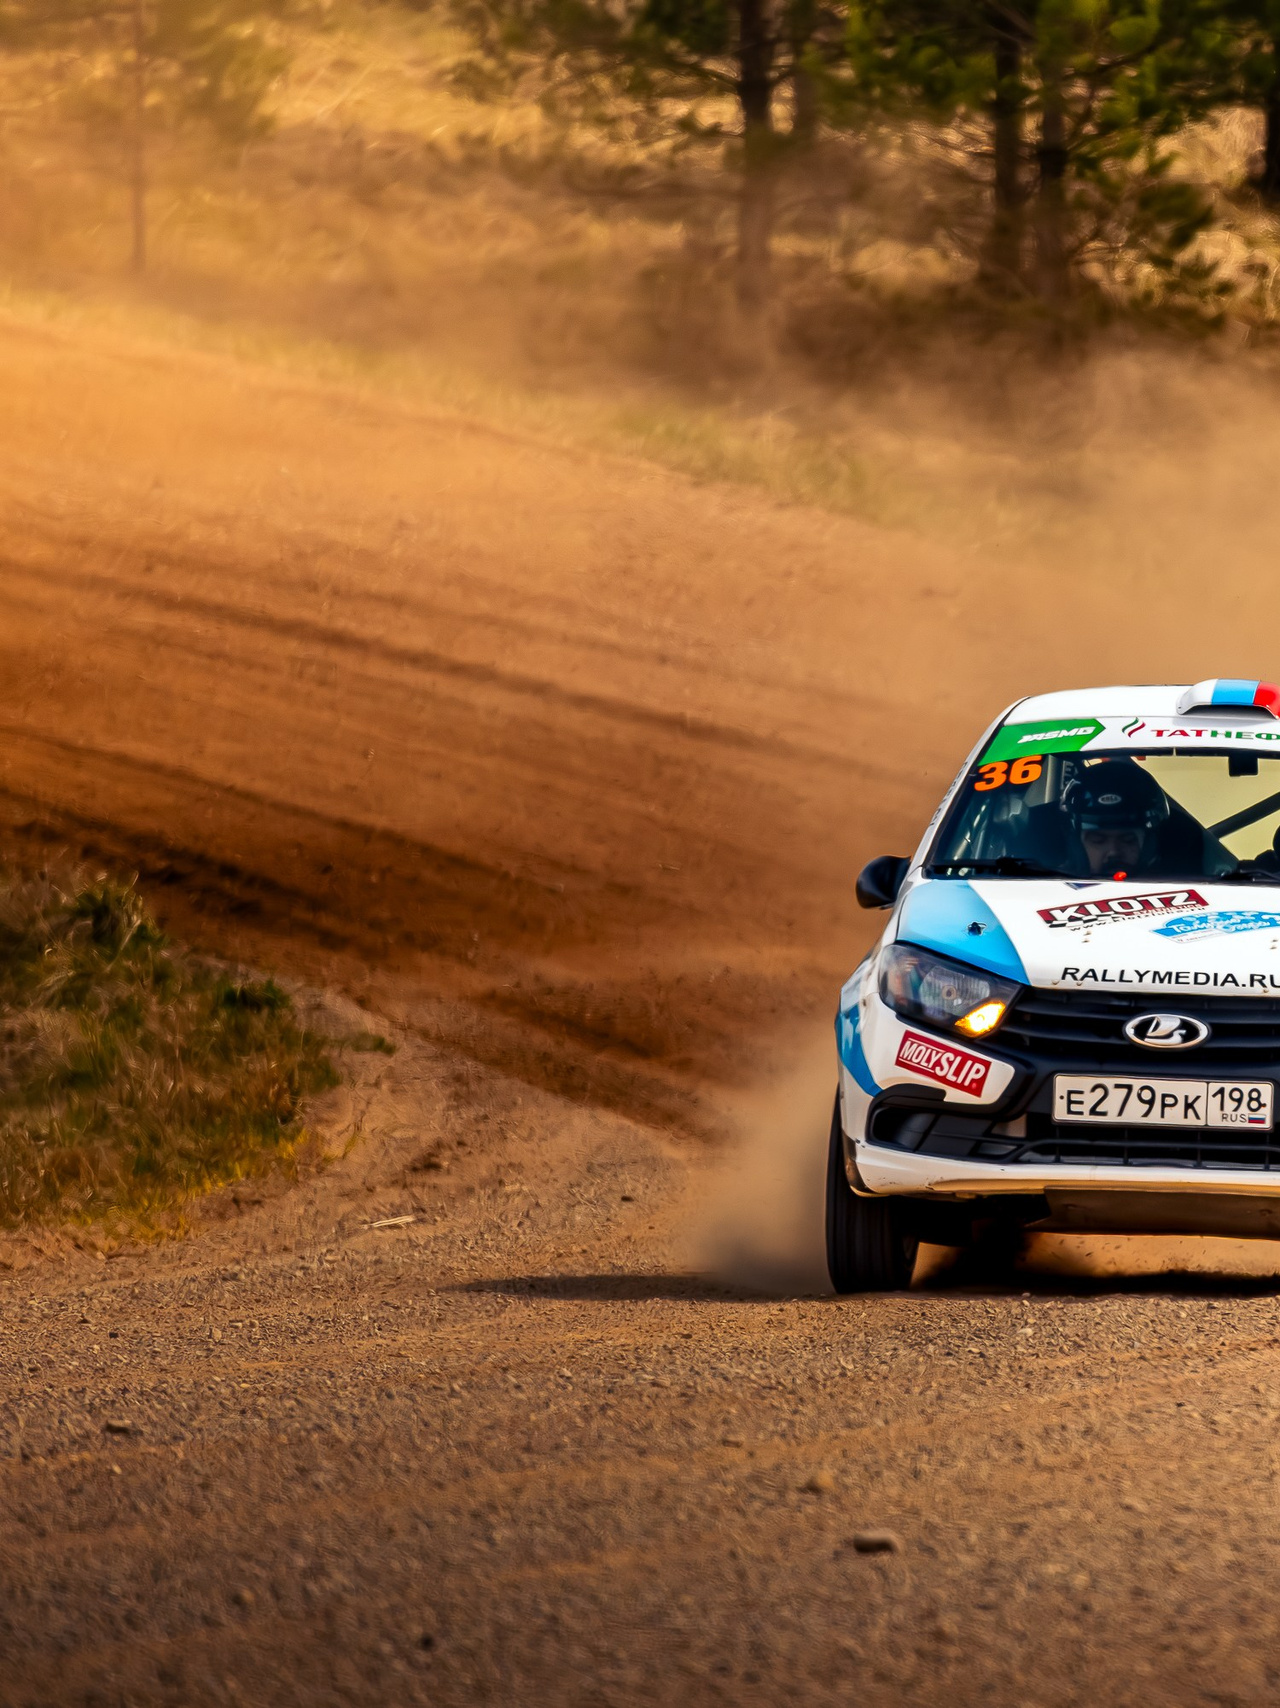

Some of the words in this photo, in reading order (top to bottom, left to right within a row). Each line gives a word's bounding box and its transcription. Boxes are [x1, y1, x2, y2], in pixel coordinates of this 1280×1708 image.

[974, 755, 1043, 791] 36
[1048, 891, 1198, 922] KLOTZ
[898, 1040, 987, 1087] MOLYSLIP
[1211, 1086, 1262, 1113] 198
[1221, 1113, 1248, 1123] RUS
